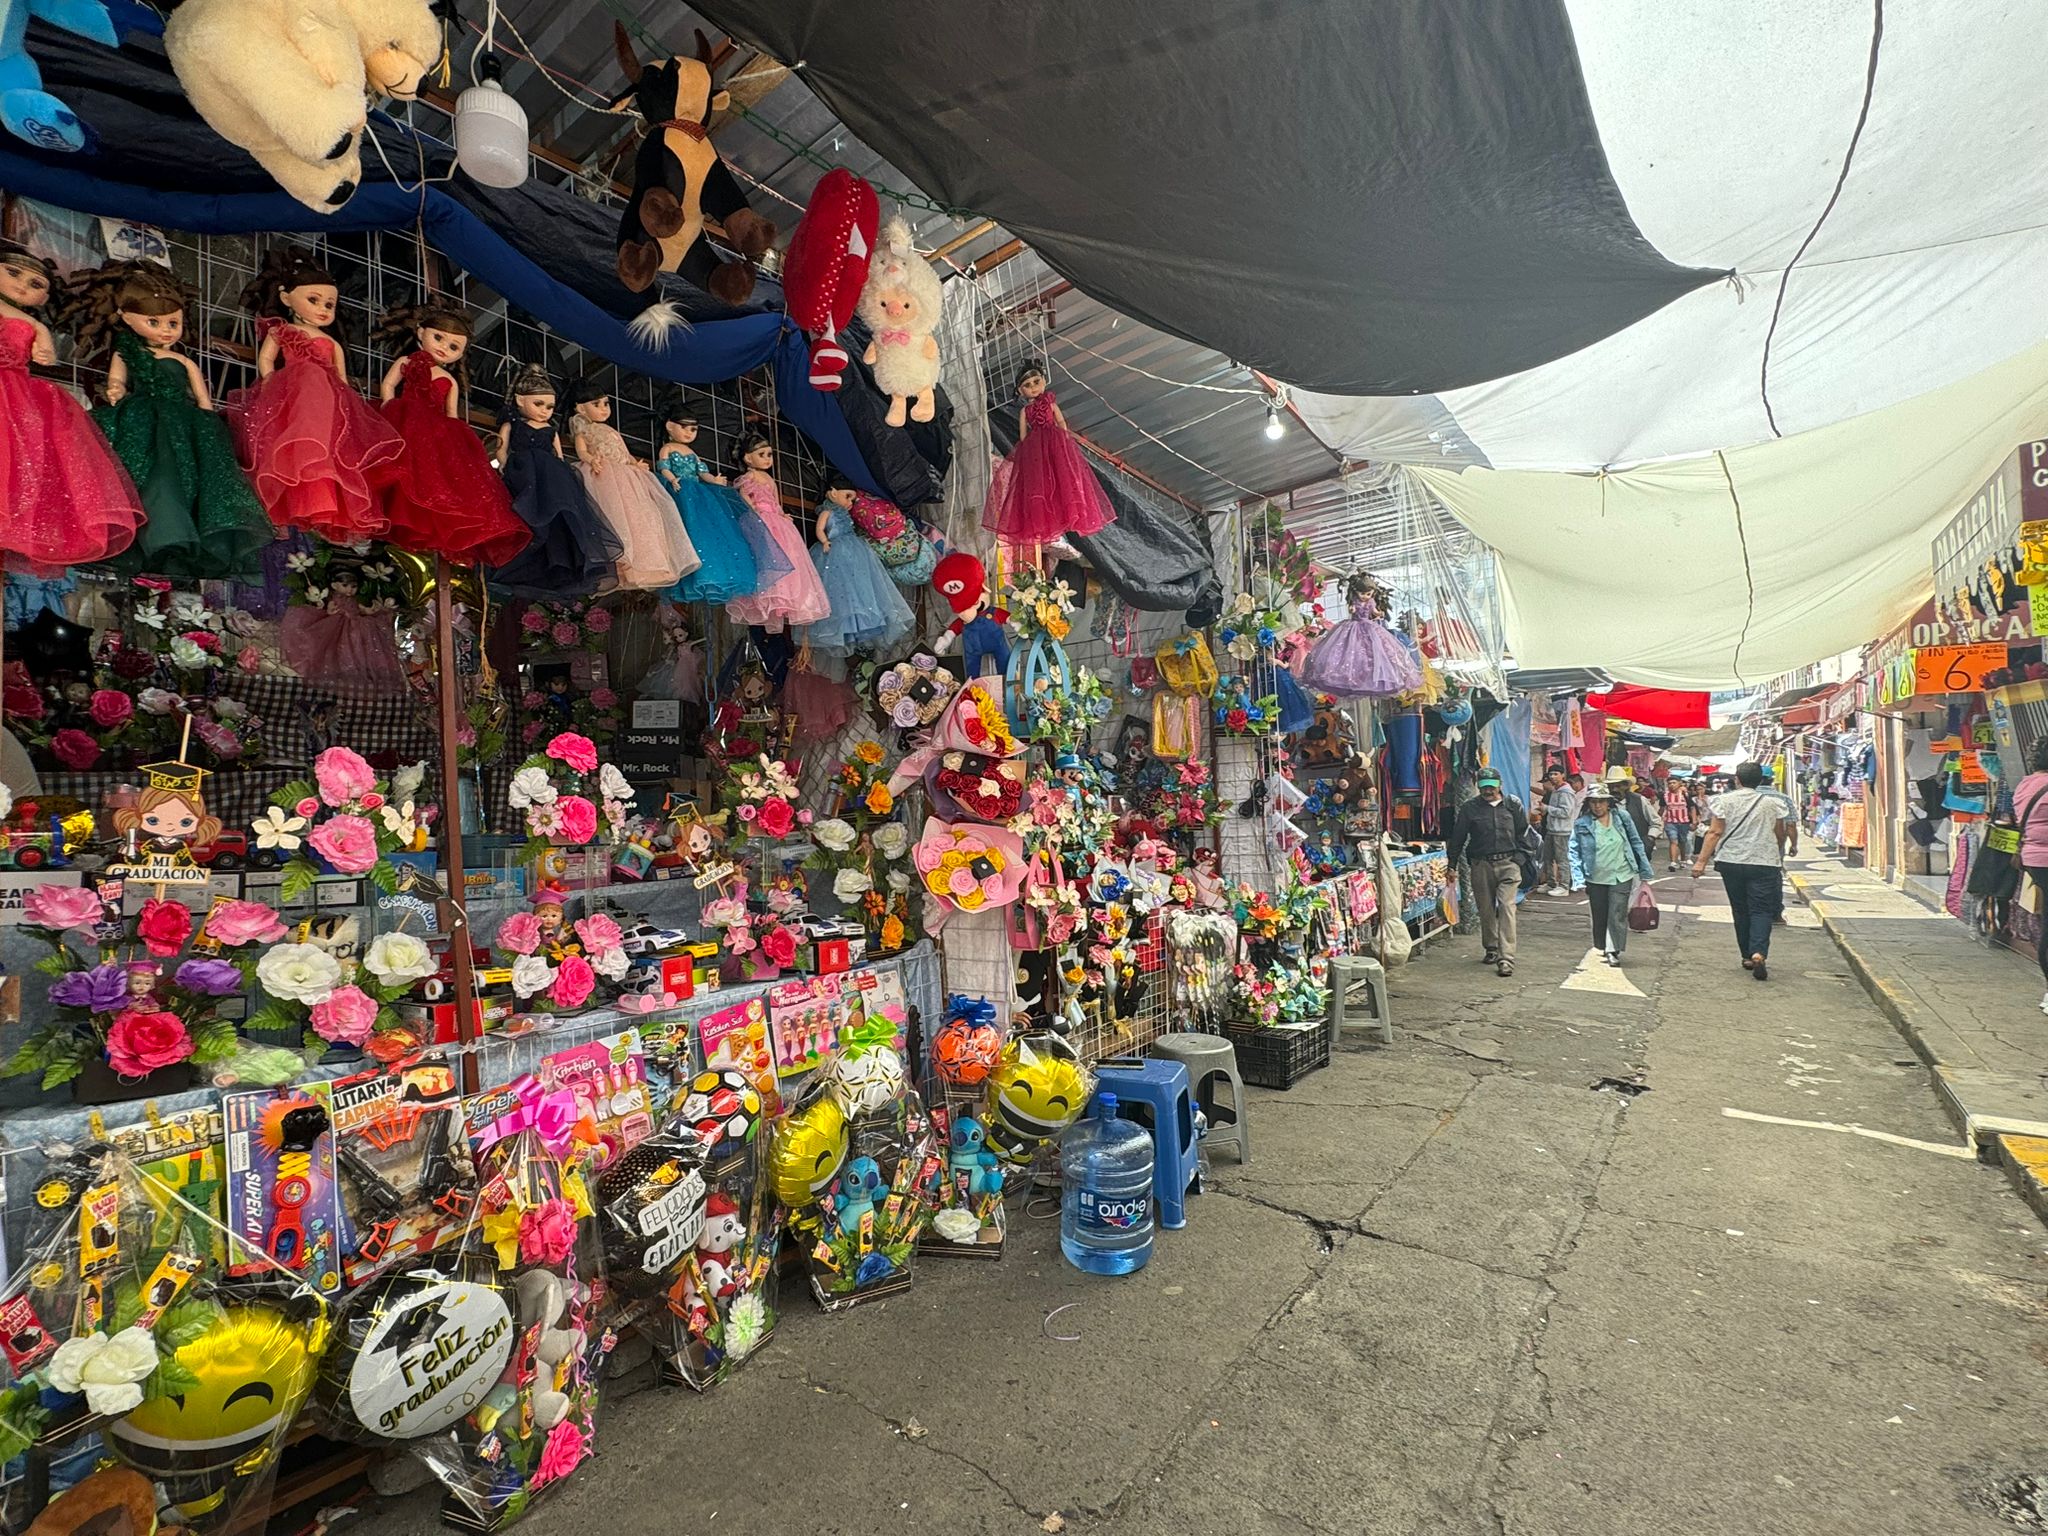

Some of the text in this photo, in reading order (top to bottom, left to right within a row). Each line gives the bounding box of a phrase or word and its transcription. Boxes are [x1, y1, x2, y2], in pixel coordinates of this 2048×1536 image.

[1936, 474, 2008, 586] PAPELERIA
[948, 582, 961, 592] M
[1944, 654, 1972, 691] 6
[627, 735, 680, 745] Mr. Rock
[622, 763, 671, 773] Mr. Rock
[153, 856, 170, 867] MI
[552, 1059, 597, 1080] Kitchen
[332, 1079, 386, 1112] LITARY
[333, 1094, 398, 1129] EAPONS
[470, 1114, 493, 1130] Spin
[245, 1172, 263, 1217] SUPER
[400, 1325, 472, 1388] Feliz
[379, 1315, 509, 1432] graduación
